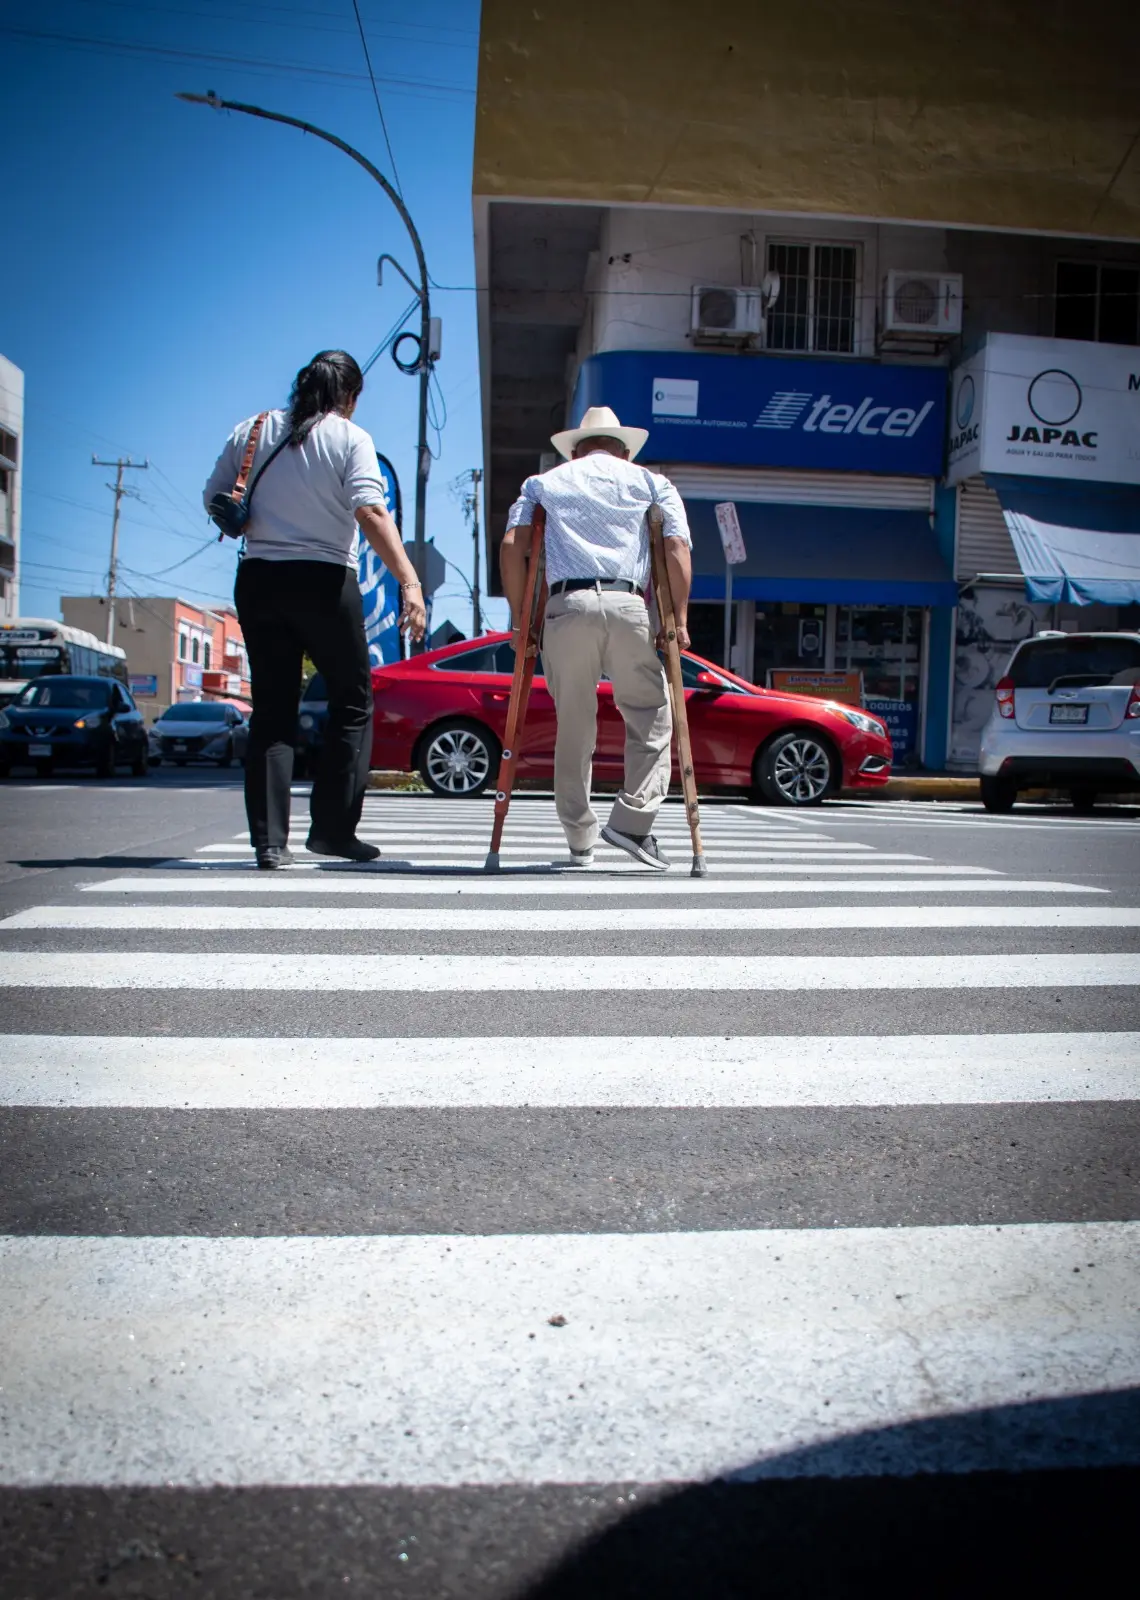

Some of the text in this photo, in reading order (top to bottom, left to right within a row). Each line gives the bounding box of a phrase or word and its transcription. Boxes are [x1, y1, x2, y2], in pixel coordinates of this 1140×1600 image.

[653, 417, 748, 428] DISTRIBUIDOR AUTORIZADO
[802, 394, 935, 437] telcel
[1006, 425, 1099, 448] JAPAC
[1032, 450, 1054, 458] SALUD
